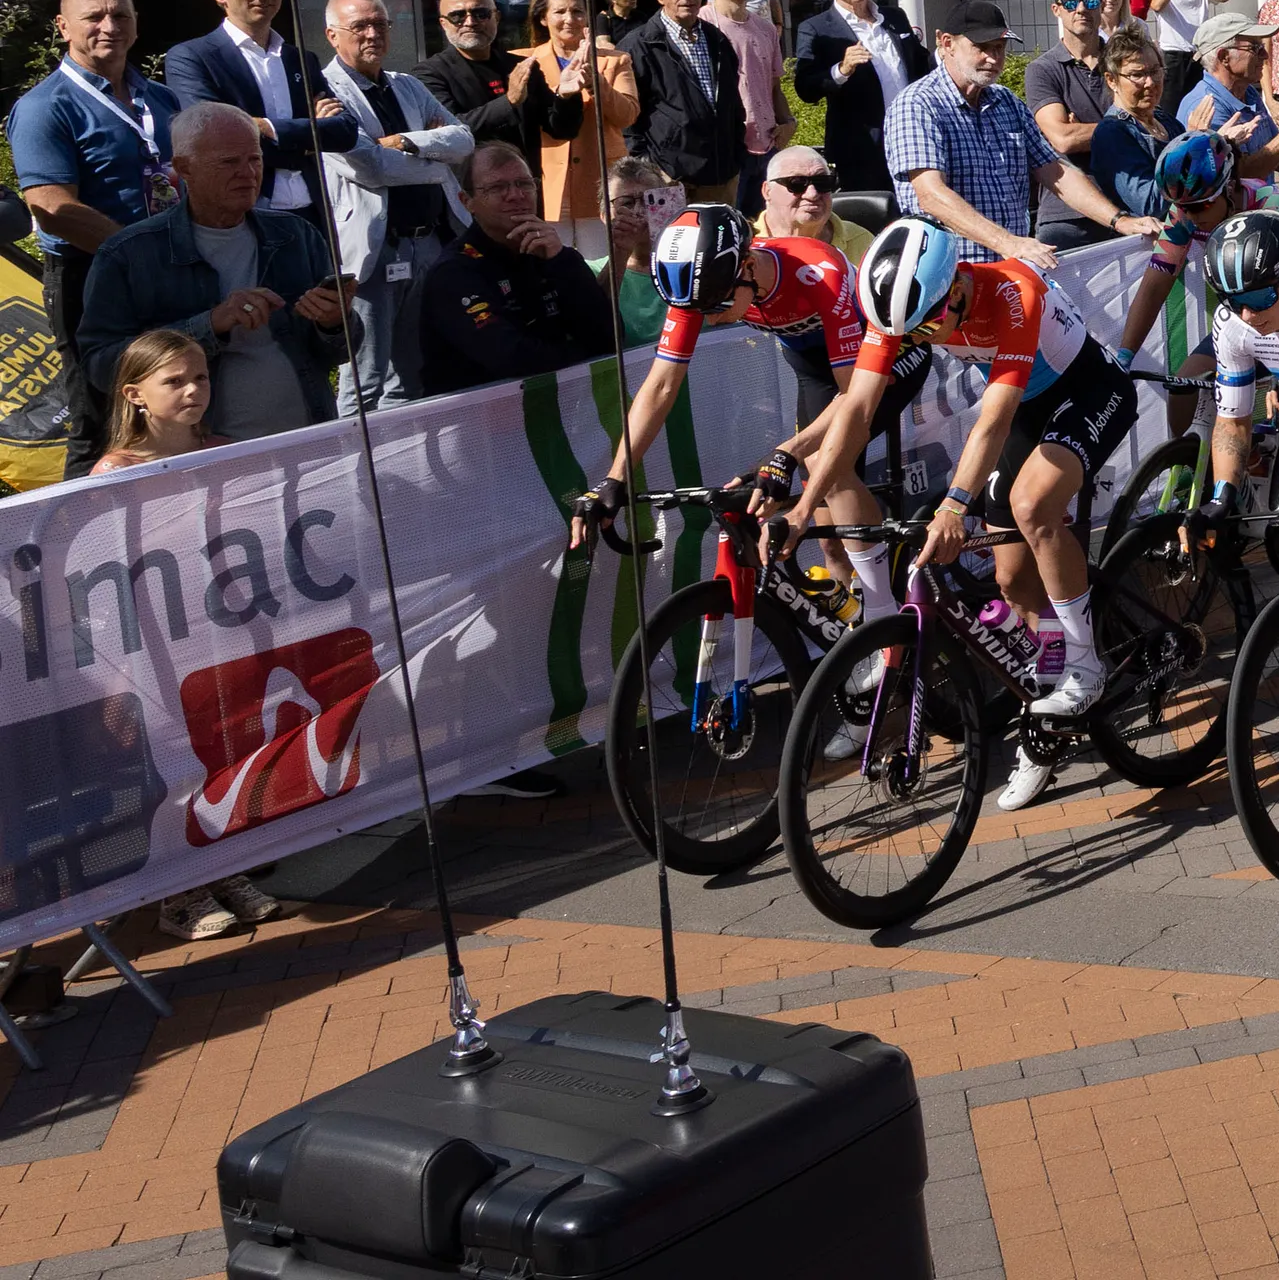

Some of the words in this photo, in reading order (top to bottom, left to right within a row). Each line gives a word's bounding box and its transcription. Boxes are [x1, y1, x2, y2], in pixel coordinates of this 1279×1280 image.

[831, 273, 850, 317] JUMBO
[1001, 282, 1025, 329] sdworx
[892, 346, 928, 378] VISMA
[996, 353, 1035, 364] SRAM
[1095, 391, 1123, 432] sdworx
[910, 470, 927, 495] 81
